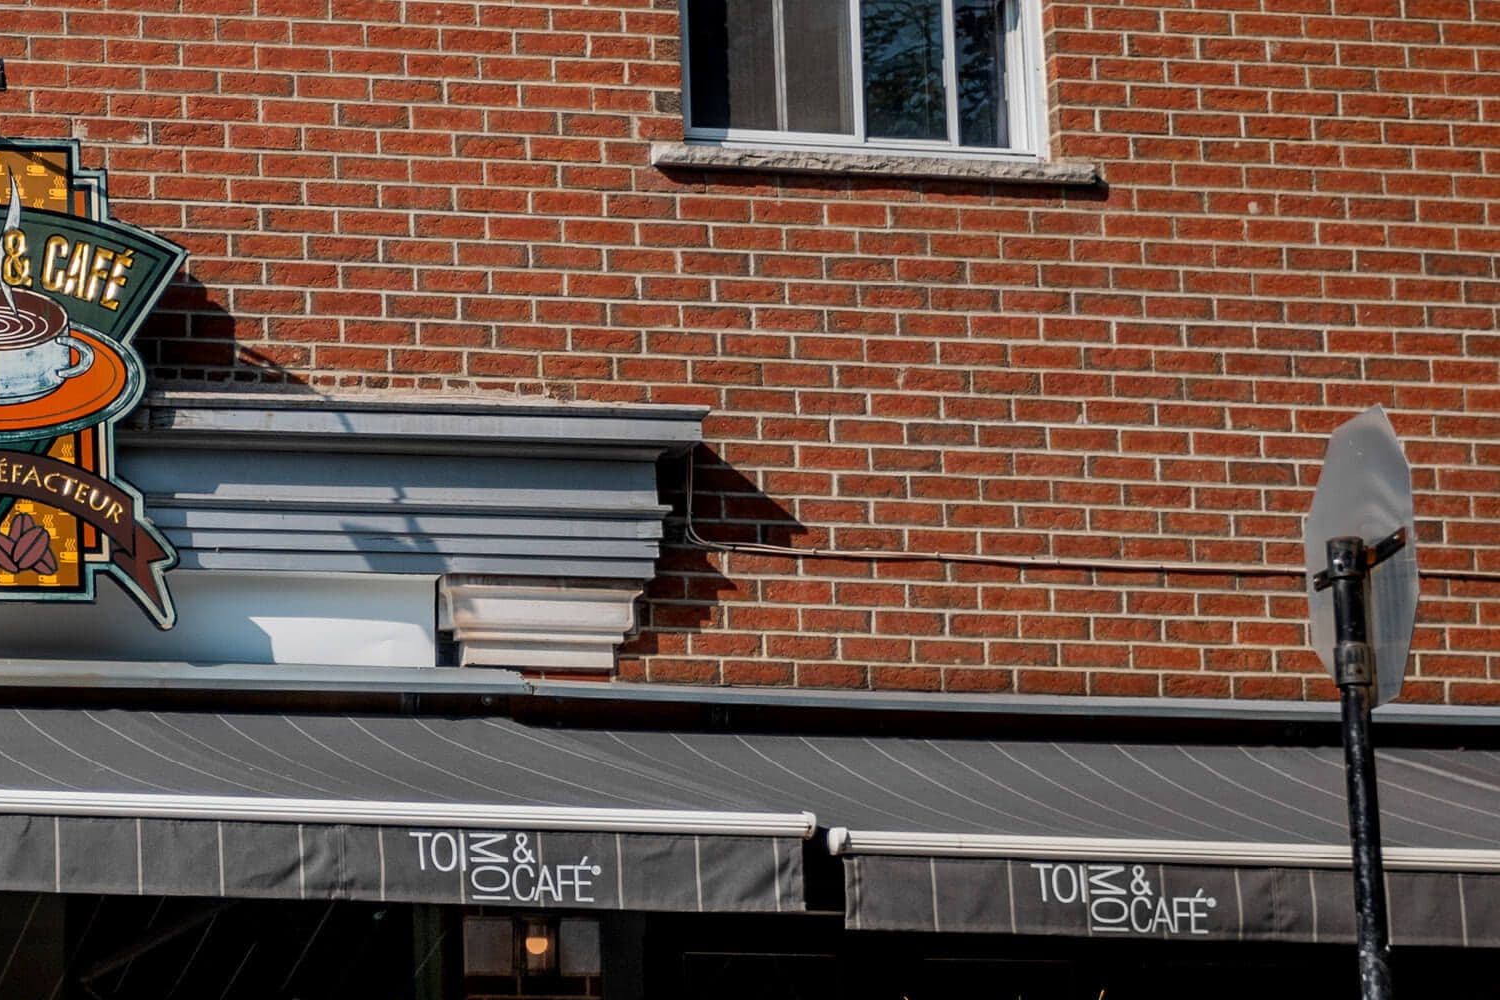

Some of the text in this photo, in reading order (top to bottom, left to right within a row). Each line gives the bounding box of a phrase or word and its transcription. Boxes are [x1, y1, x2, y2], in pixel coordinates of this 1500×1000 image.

[3, 229, 33, 288] &
[41, 235, 134, 311] CAFÉ
[408, 831, 467, 872] TOI
[469, 832, 512, 901] MOI
[512, 832, 536, 864] &
[1030, 863, 1087, 904] TOI
[1087, 865, 1130, 932] MOI
[1130, 864, 1153, 896] &
